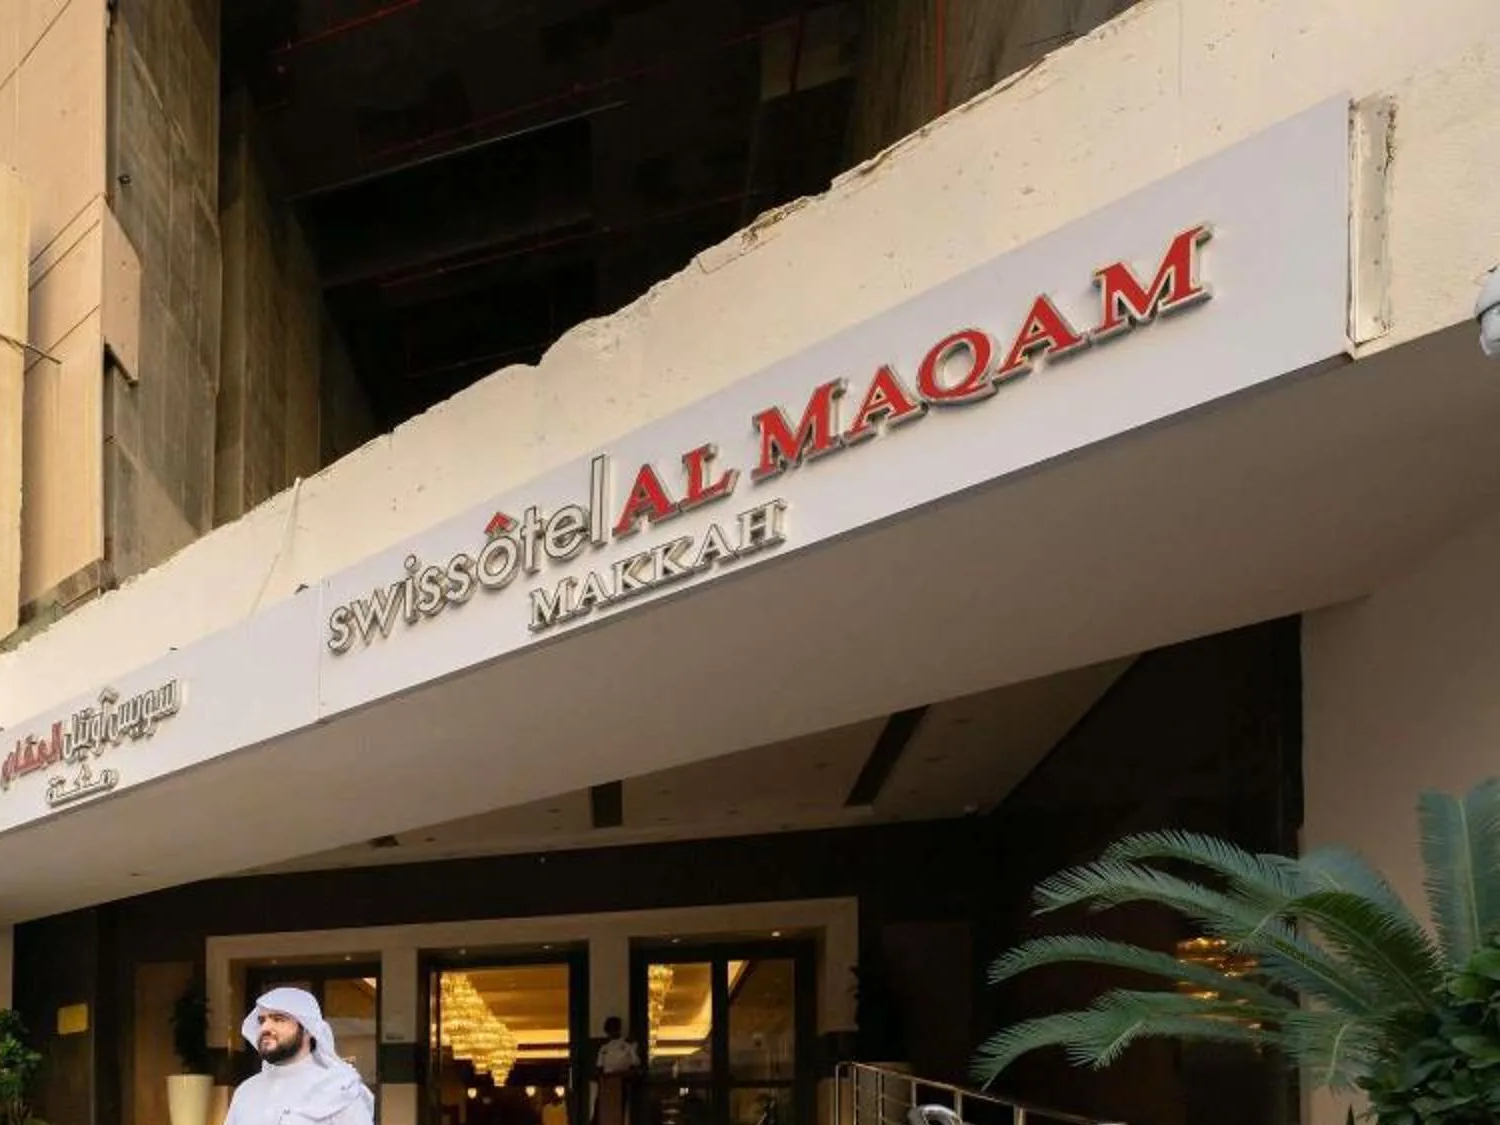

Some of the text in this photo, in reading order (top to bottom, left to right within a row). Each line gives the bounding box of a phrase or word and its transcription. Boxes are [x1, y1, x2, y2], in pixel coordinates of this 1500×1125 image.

[327, 223, 1212, 654] swissôtel AL MAQAM
[528, 499, 786, 630] MAKKAH
